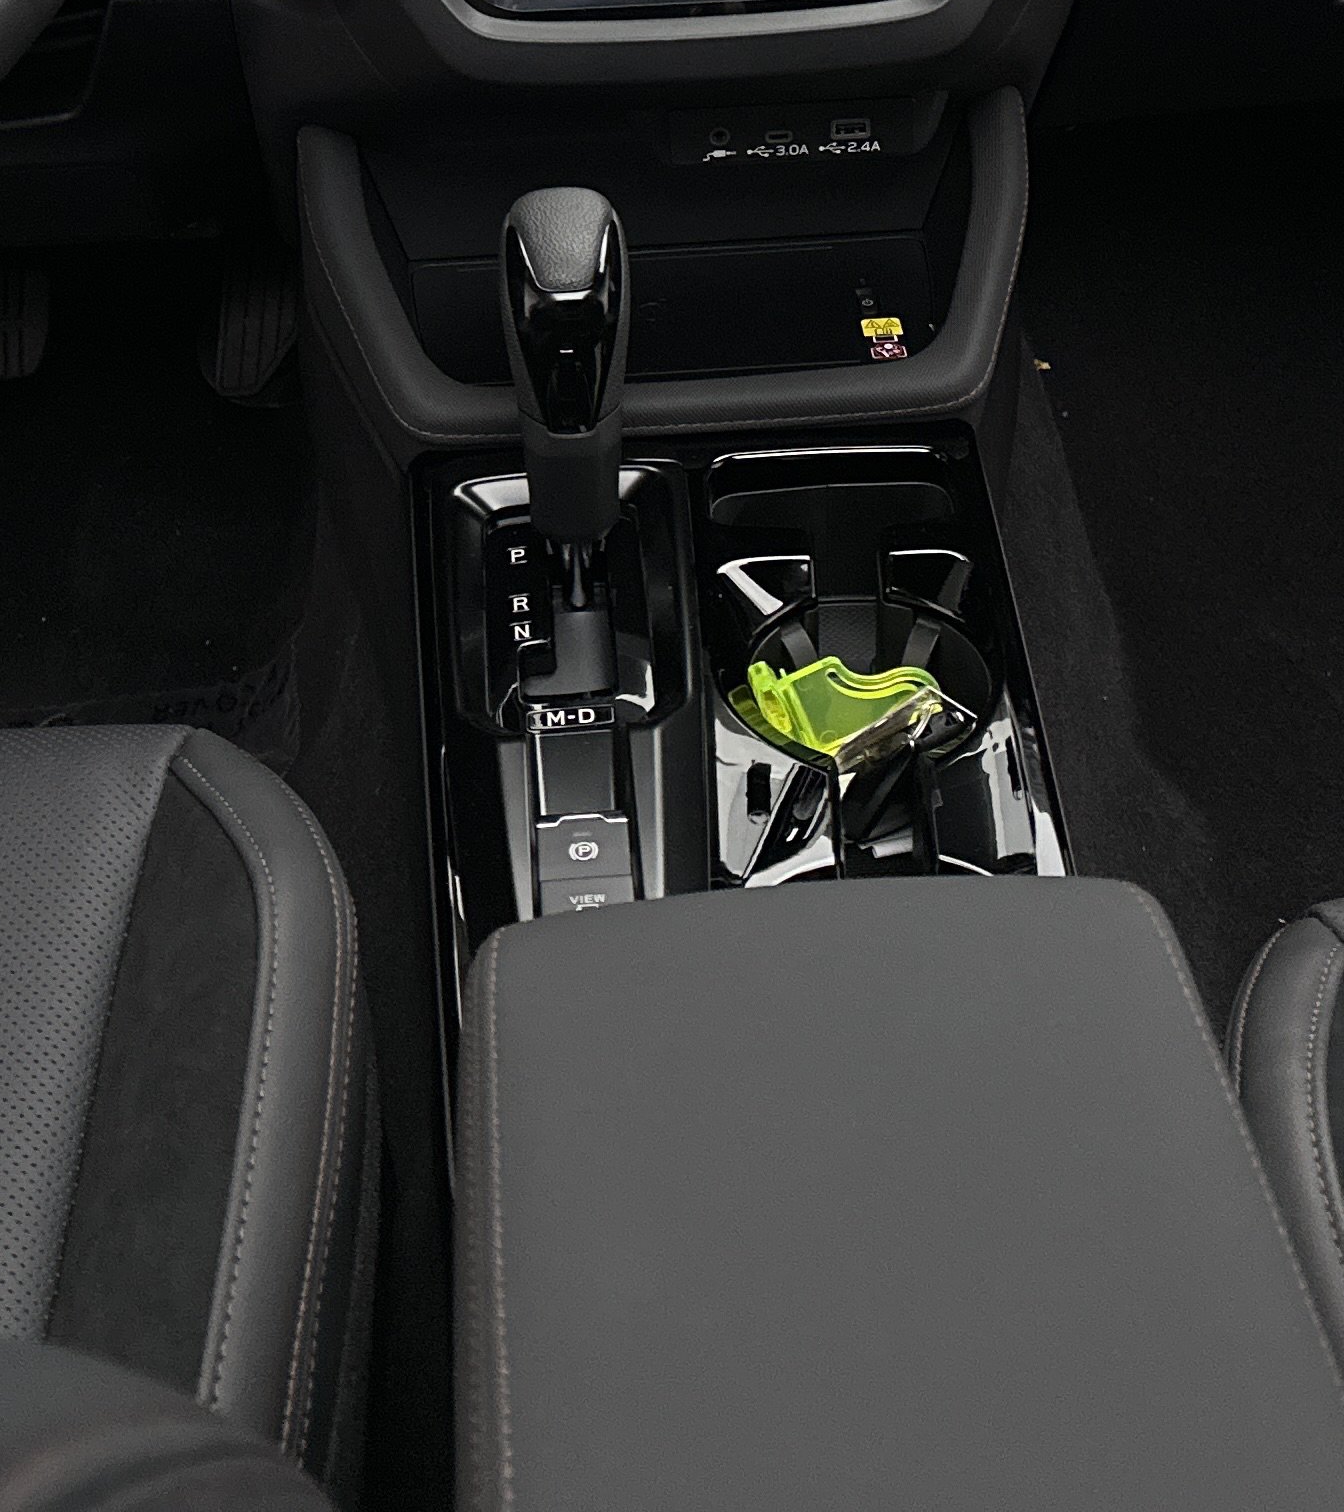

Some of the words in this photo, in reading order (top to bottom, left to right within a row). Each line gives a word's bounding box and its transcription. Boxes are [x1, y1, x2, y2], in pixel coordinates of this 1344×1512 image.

[775, 144, 809, 156] 3.0A
[847, 140, 881, 153] 2.4A
[510, 549, 525, 563] P
[513, 596, 530, 612] R
[514, 624, 530, 639] N
[546, 708, 595, 727] M-D
[569, 893, 606, 905] VIEW
